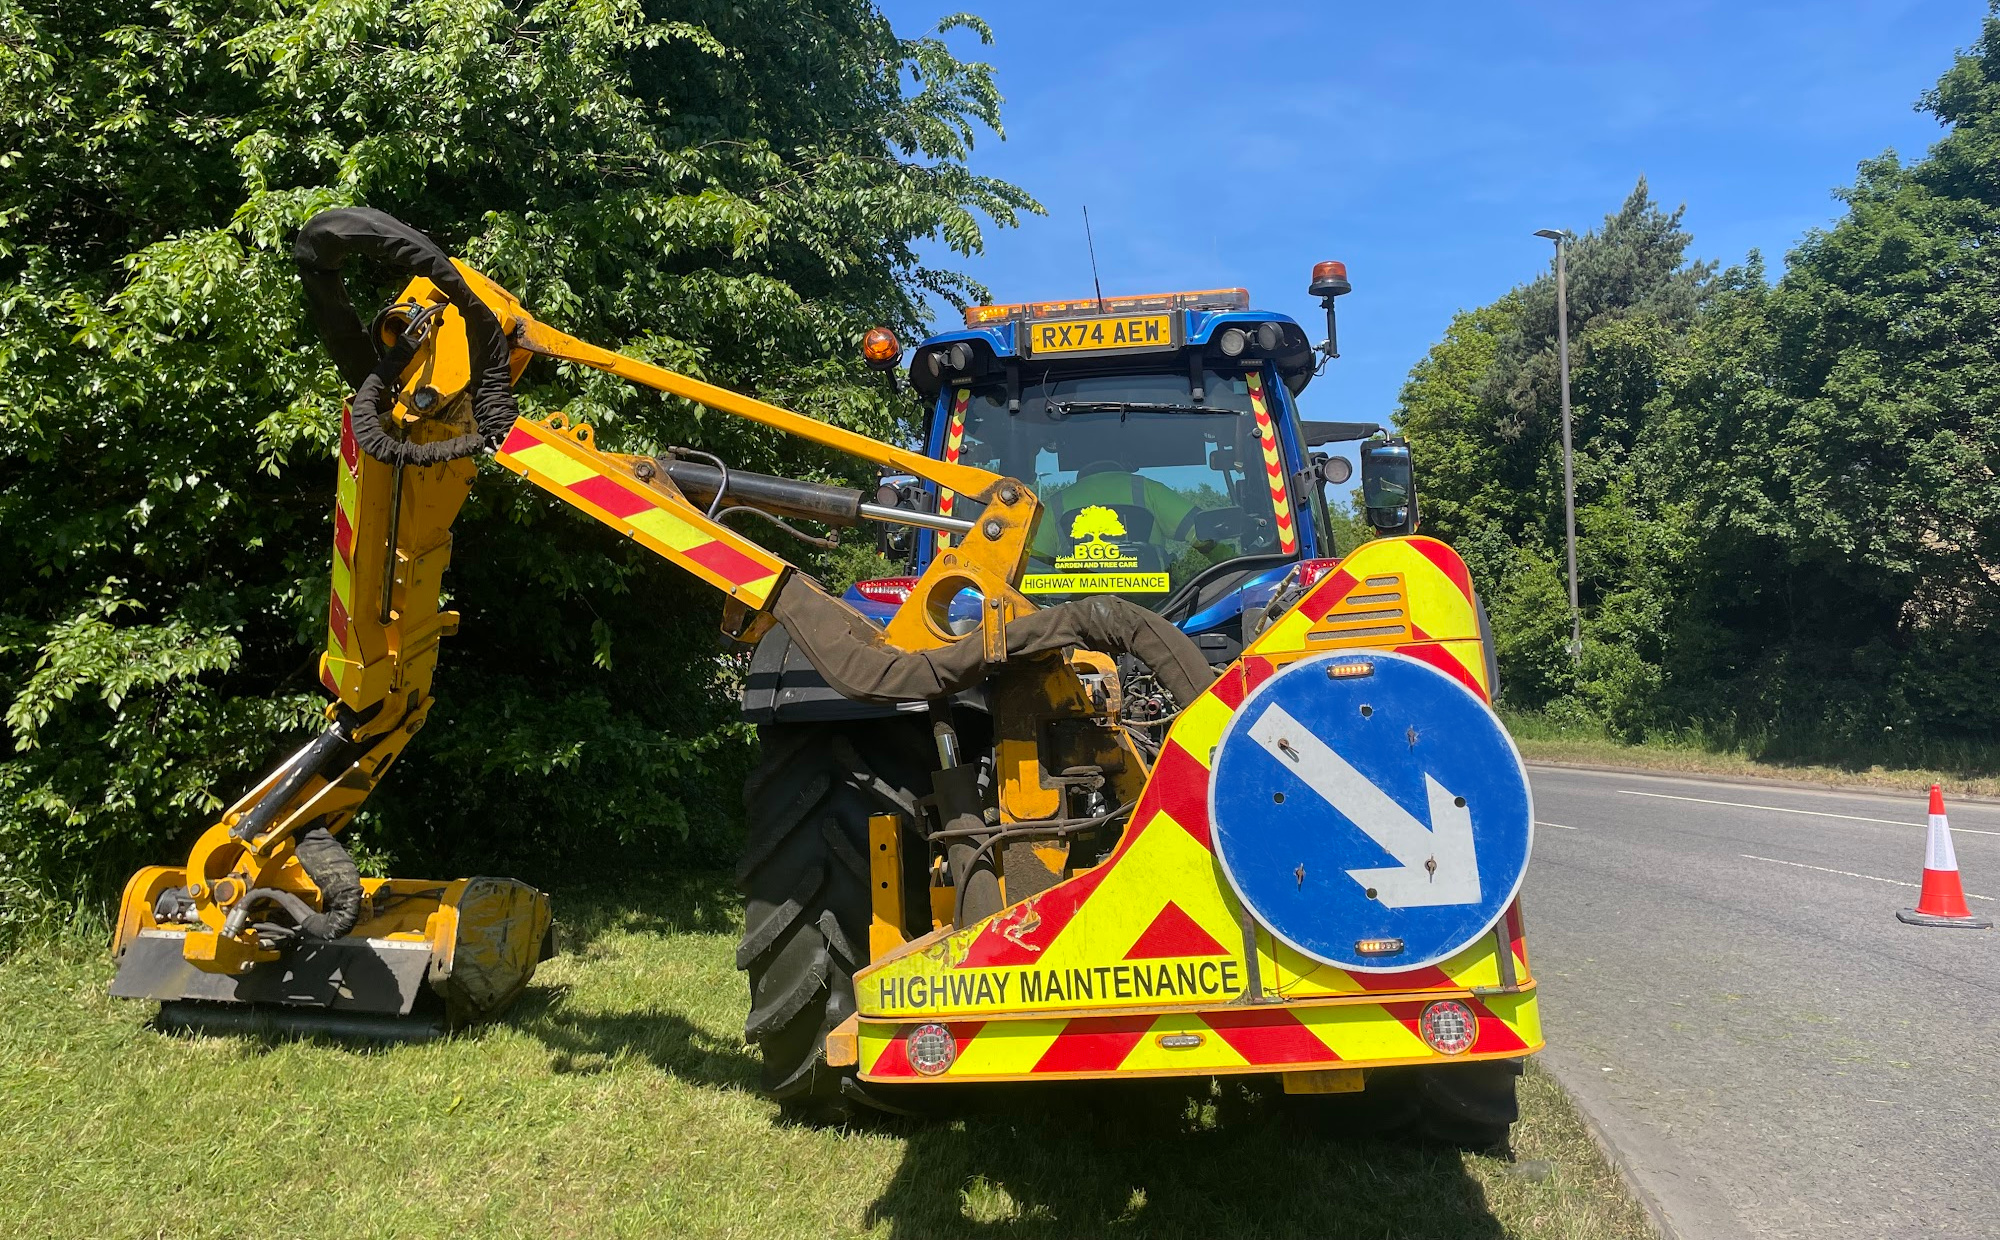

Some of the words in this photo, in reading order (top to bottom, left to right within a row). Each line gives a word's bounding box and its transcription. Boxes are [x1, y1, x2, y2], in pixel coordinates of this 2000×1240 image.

[1042, 323, 1105, 349] RX74
[1113, 319, 1159, 343] AEW
[1074, 544, 1120, 560] BGG
[1025, 577, 1076, 589] HIGHWAY
[1079, 576, 1165, 588] MAINTENANCE
[879, 971, 1011, 1010] HIGHWAY
[1019, 960, 1241, 1003] MAINTENANCE
